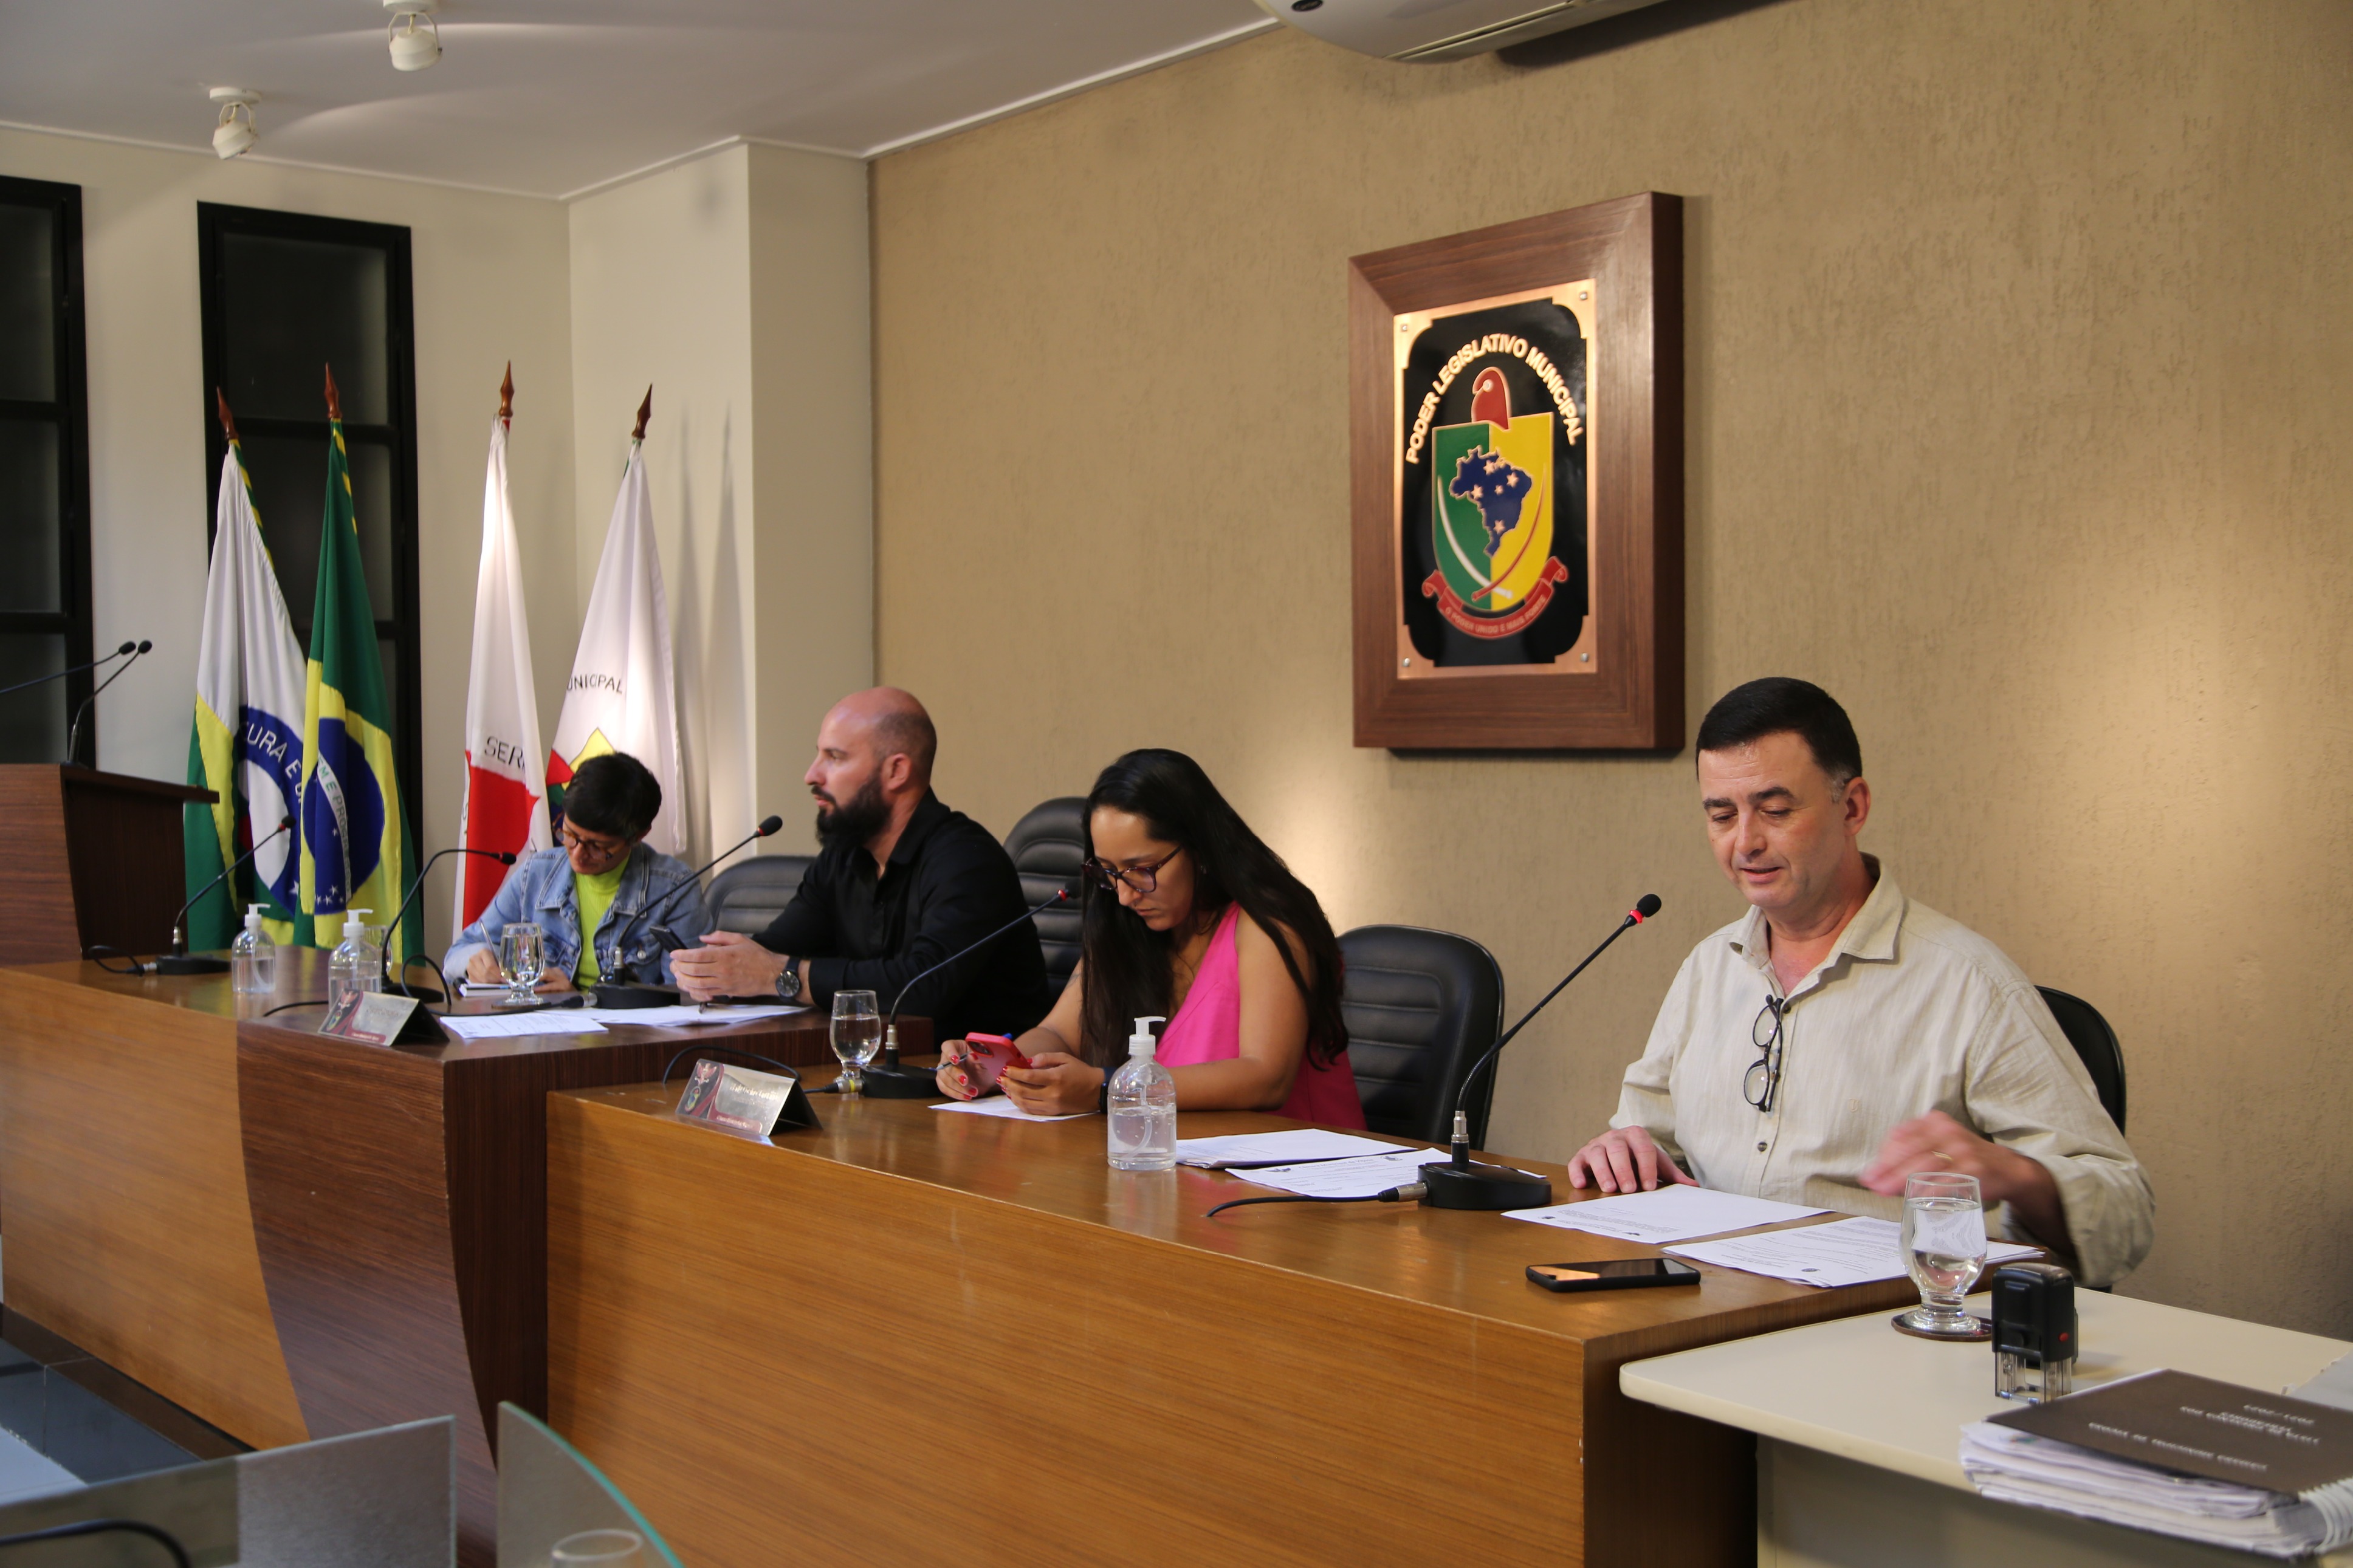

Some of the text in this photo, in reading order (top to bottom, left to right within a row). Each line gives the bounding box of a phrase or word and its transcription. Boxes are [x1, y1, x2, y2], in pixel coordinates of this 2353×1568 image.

[1406, 333, 1584, 465] PODER LEGISLATIVO MUNICIPAL
[246, 721, 287, 763] URA
[484, 735, 526, 773] SER
